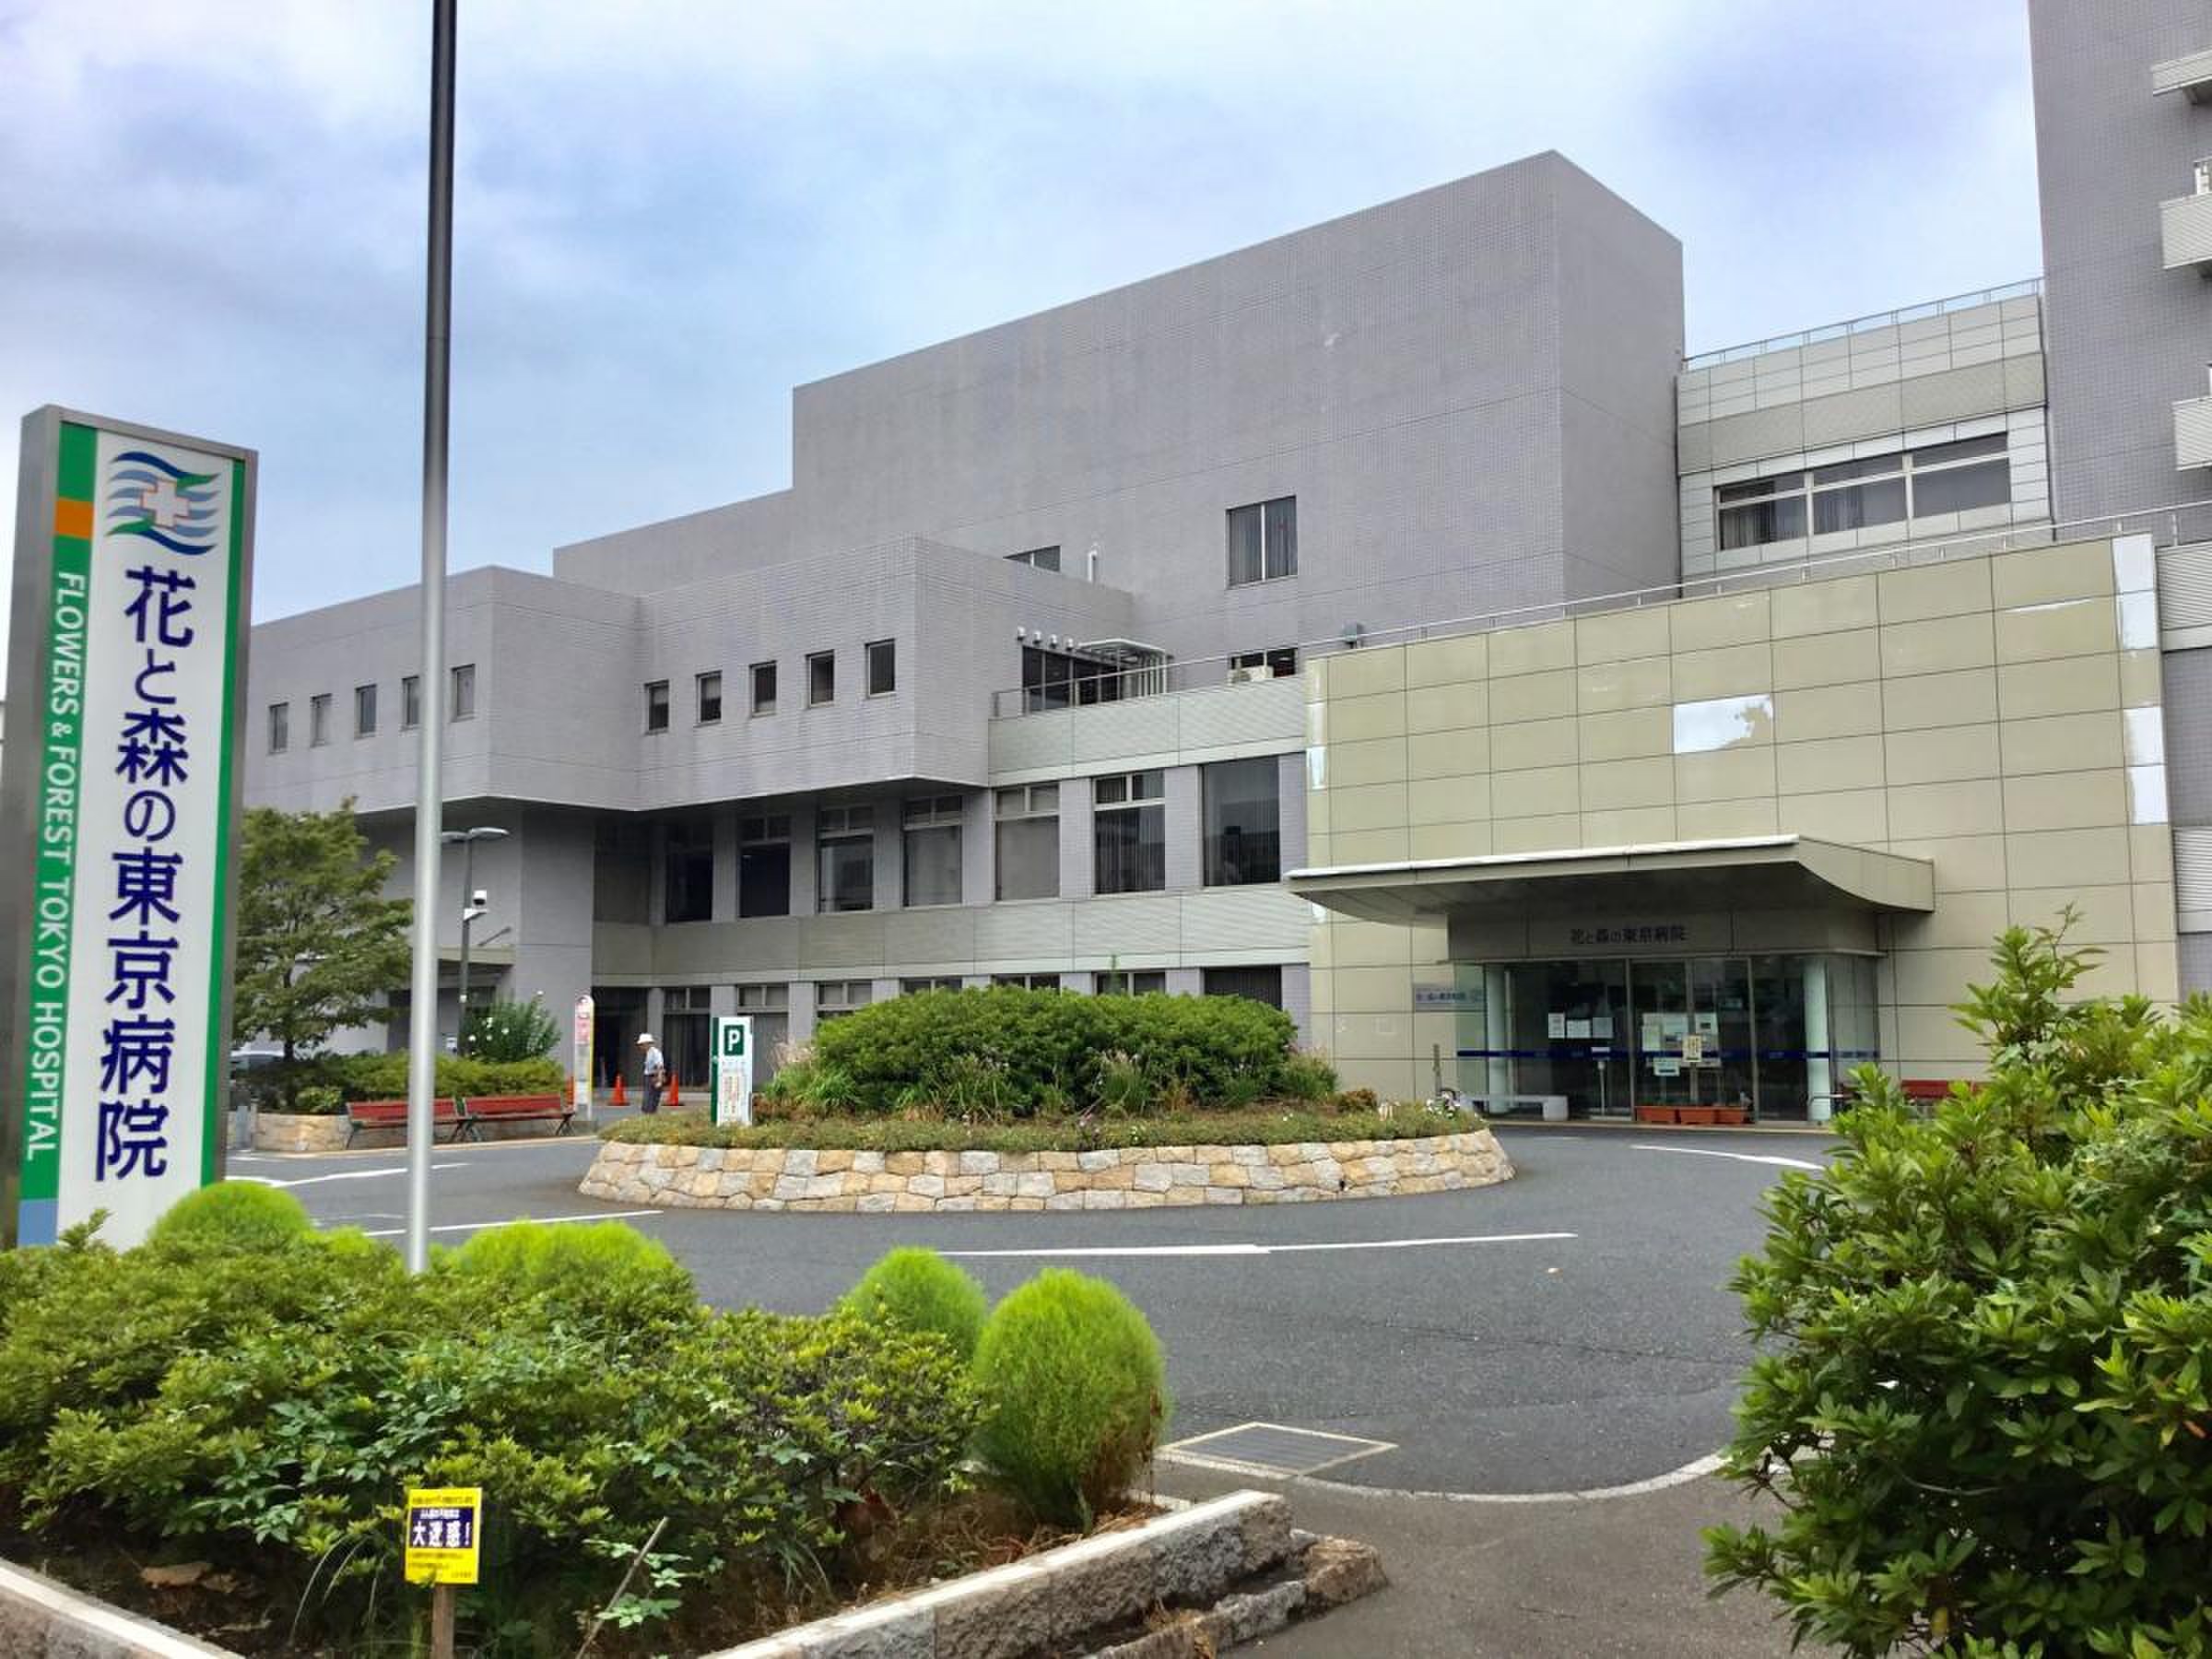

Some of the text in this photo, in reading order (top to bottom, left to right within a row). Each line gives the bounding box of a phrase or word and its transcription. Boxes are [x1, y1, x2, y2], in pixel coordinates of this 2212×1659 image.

[26, 571, 86, 1161] FLOWERS & FOREST TOKYO HOSPITAL
[95, 565, 196, 1182] 花と森の東京病院
[1570, 924, 1688, 945] 花と森の東京病院
[727, 1029, 741, 1052] P
